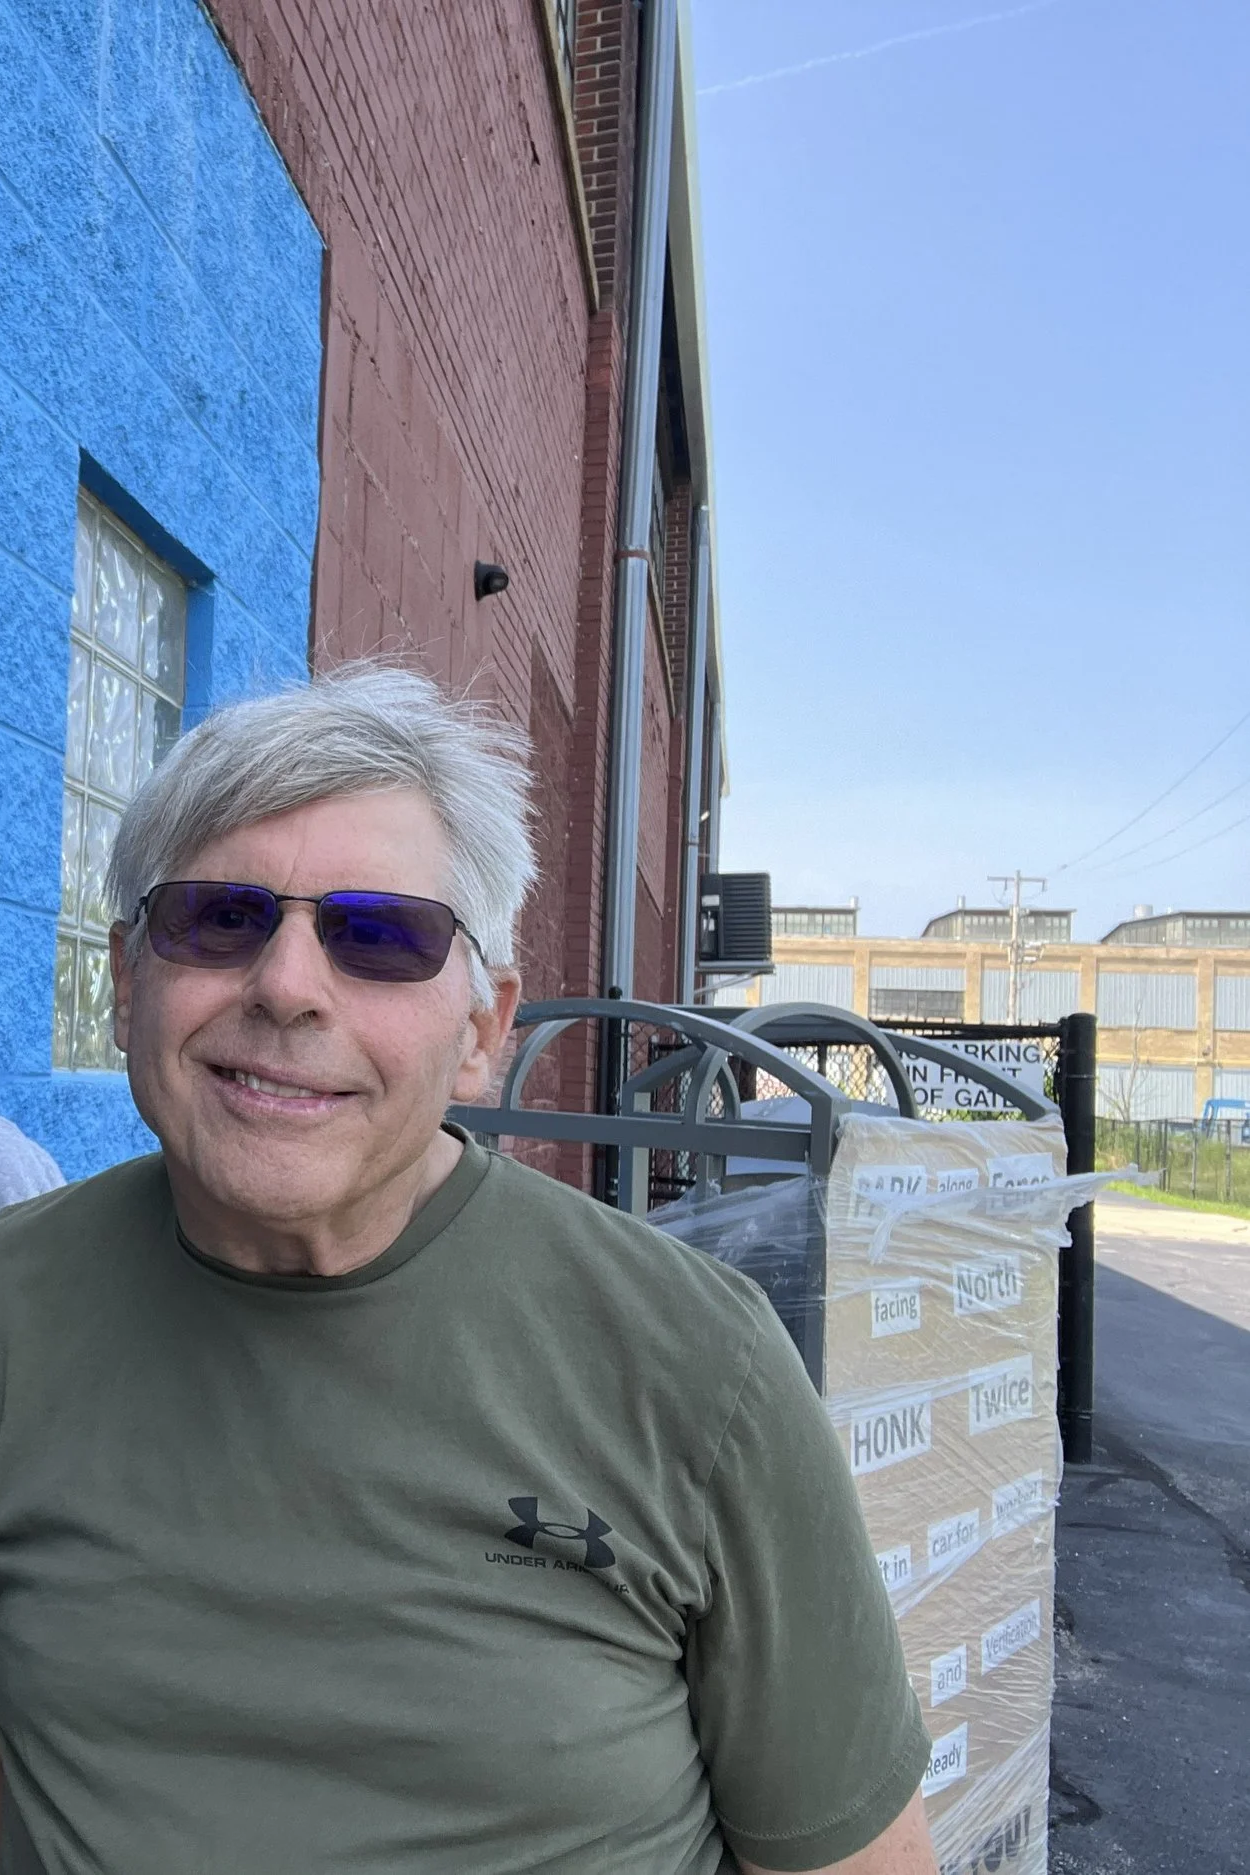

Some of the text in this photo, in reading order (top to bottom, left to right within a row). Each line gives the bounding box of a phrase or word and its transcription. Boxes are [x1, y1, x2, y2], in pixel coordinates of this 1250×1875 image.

[944, 1042, 1040, 1063] RKING
[907, 1064, 1022, 1084] IN FRT
[914, 1087, 943, 1106] OF
[874, 1260, 1017, 1323] facing North
[853, 1375, 1030, 1467] HONK Twice
[894, 1554, 908, 1580] in
[932, 1532, 953, 1558] car
[955, 1521, 975, 1546] for
[485, 1551, 630, 1594] UNDER ARMR
[937, 1656, 962, 1690] and
[925, 1743, 962, 1781] Ready
